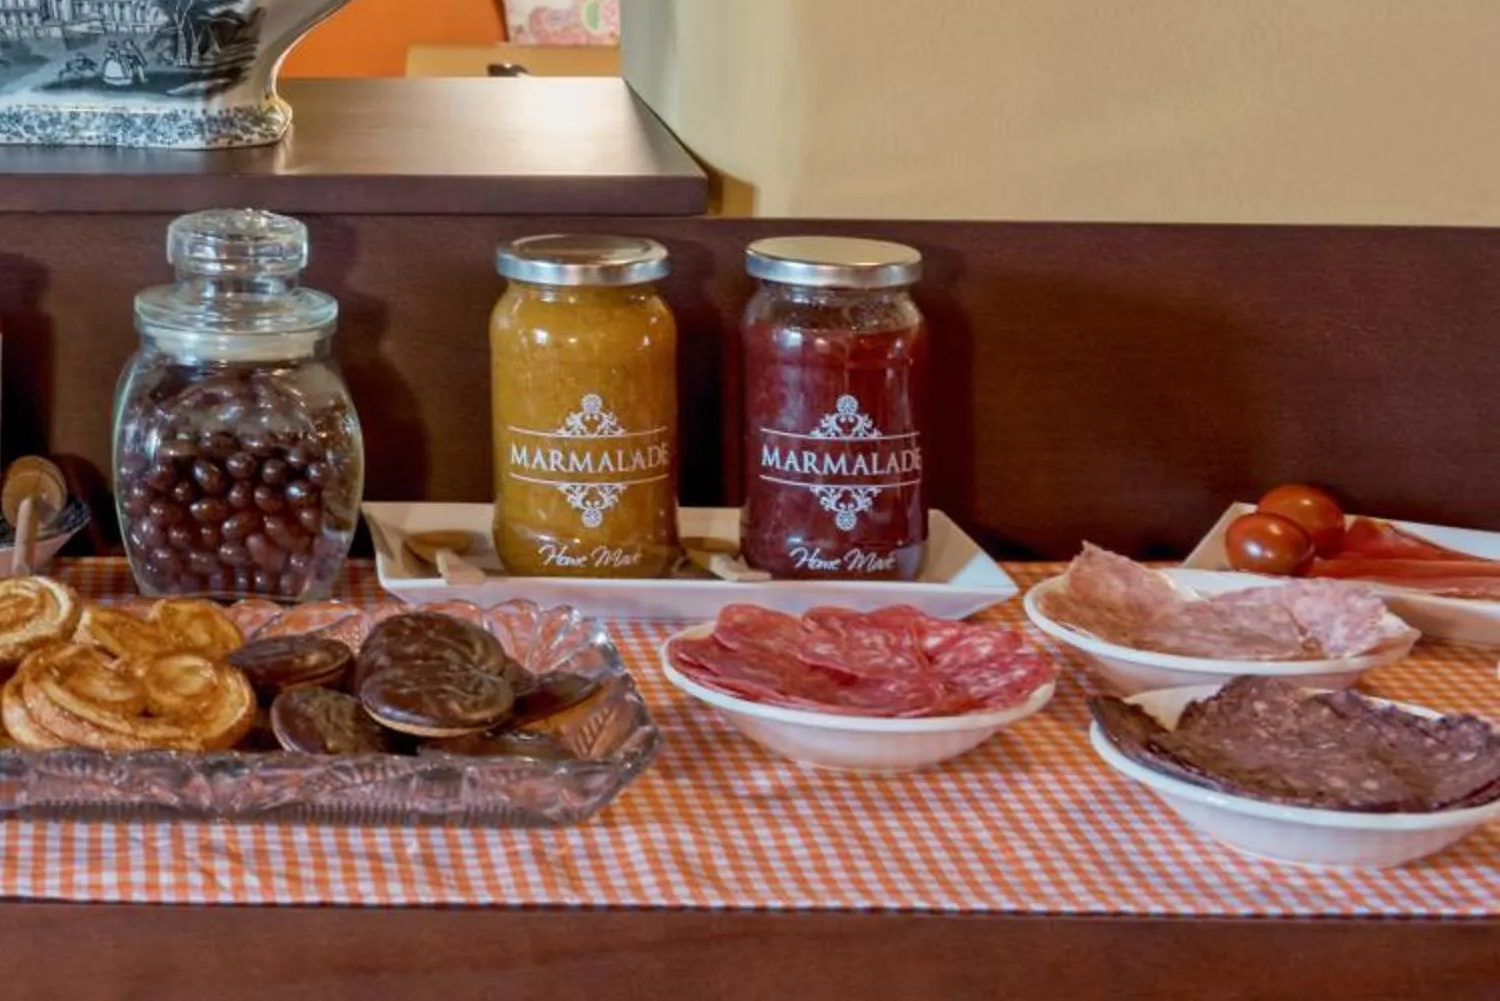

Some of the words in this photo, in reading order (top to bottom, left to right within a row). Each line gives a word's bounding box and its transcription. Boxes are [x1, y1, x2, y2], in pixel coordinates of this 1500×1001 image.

[510, 441, 669, 474] MARMALADE
[760, 443, 922, 476] MARMALADE
[537, 544, 589, 568] Home
[788, 546, 841, 571] Home
